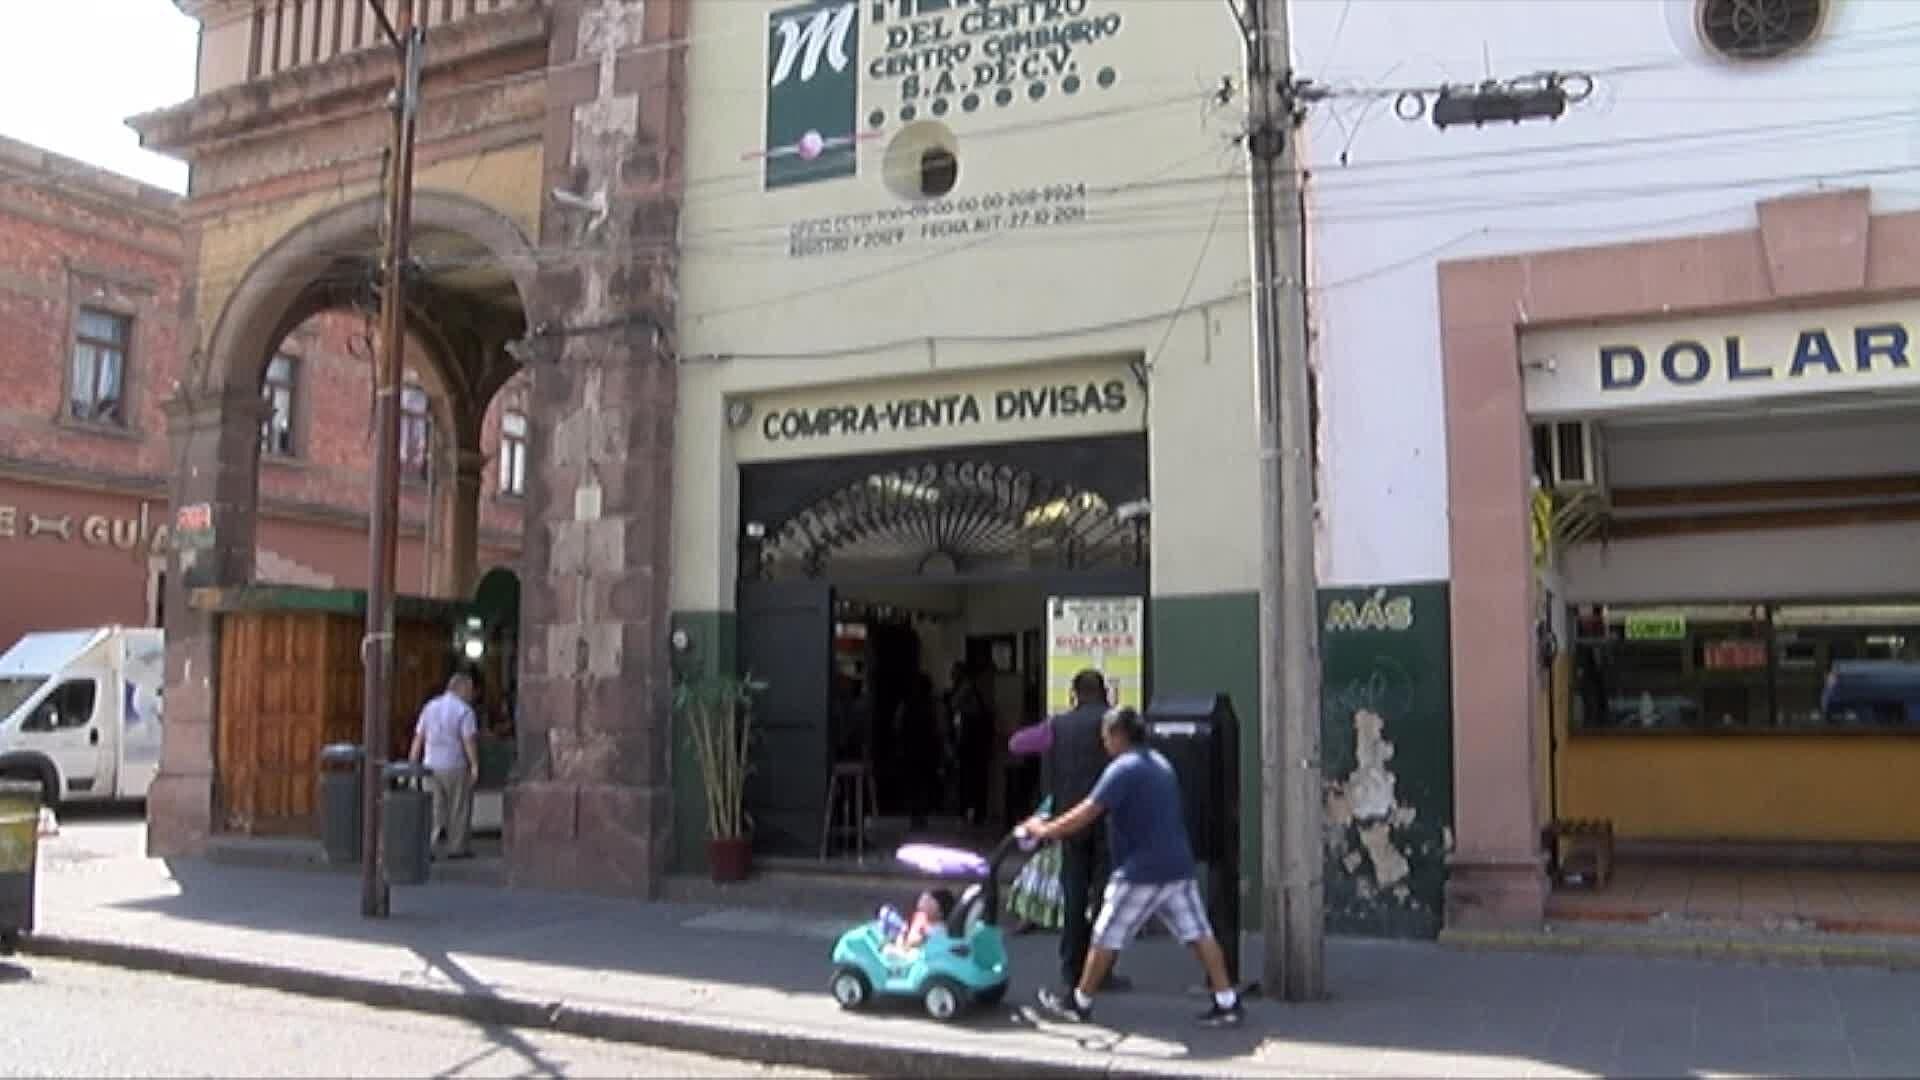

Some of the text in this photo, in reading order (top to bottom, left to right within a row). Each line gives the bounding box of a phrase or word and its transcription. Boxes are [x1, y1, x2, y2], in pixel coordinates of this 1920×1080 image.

[886, 18, 951, 50] DEL
[960, 0, 1087, 35] CENTRO
[869, 42, 971, 79] CENTRO
[1600, 322, 1910, 390] DOLAR
[763, 380, 1127, 440] COMPRA-VENTA DIVISAS
[1325, 587, 1414, 631] MÁS
